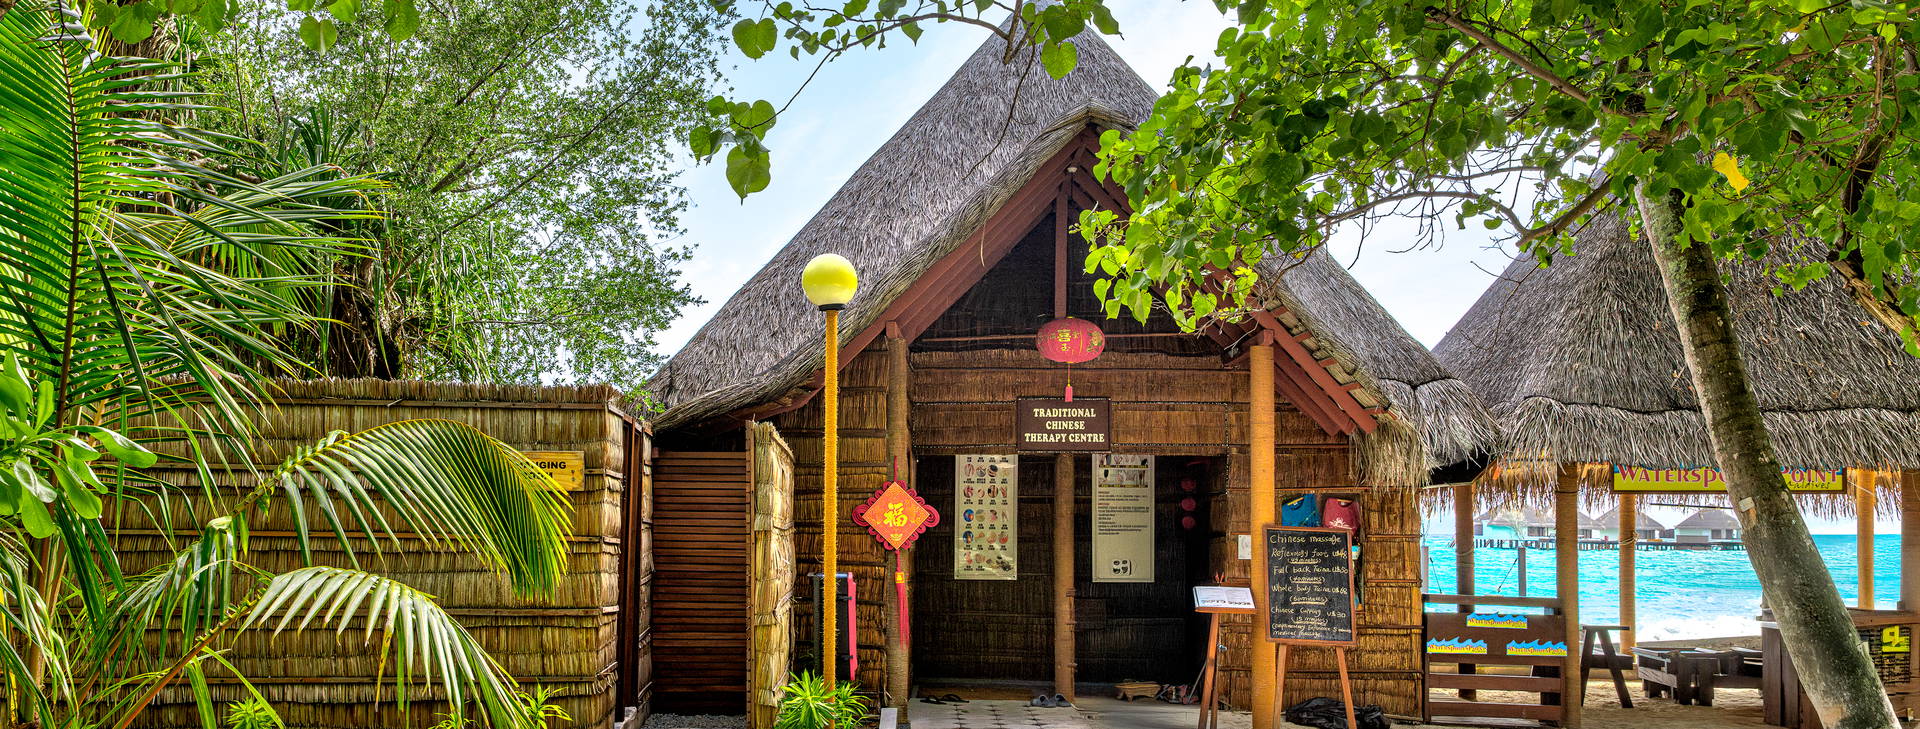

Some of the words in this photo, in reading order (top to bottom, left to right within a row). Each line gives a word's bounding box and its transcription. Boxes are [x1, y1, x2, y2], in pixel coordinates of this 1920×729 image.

[1033, 408, 1096, 417] TRADITIONAL
[1045, 420, 1086, 430] CHINESE
[1024, 433, 1067, 442] THERAPY
[1068, 433, 1105, 442] CENTRE
[883, 502, 908, 527] 福
[1269, 533, 1306, 543] Chinese
[1310, 534, 1342, 545] massage
[1271, 583, 1293, 592] Whole
[1296, 584, 1311, 594] body
